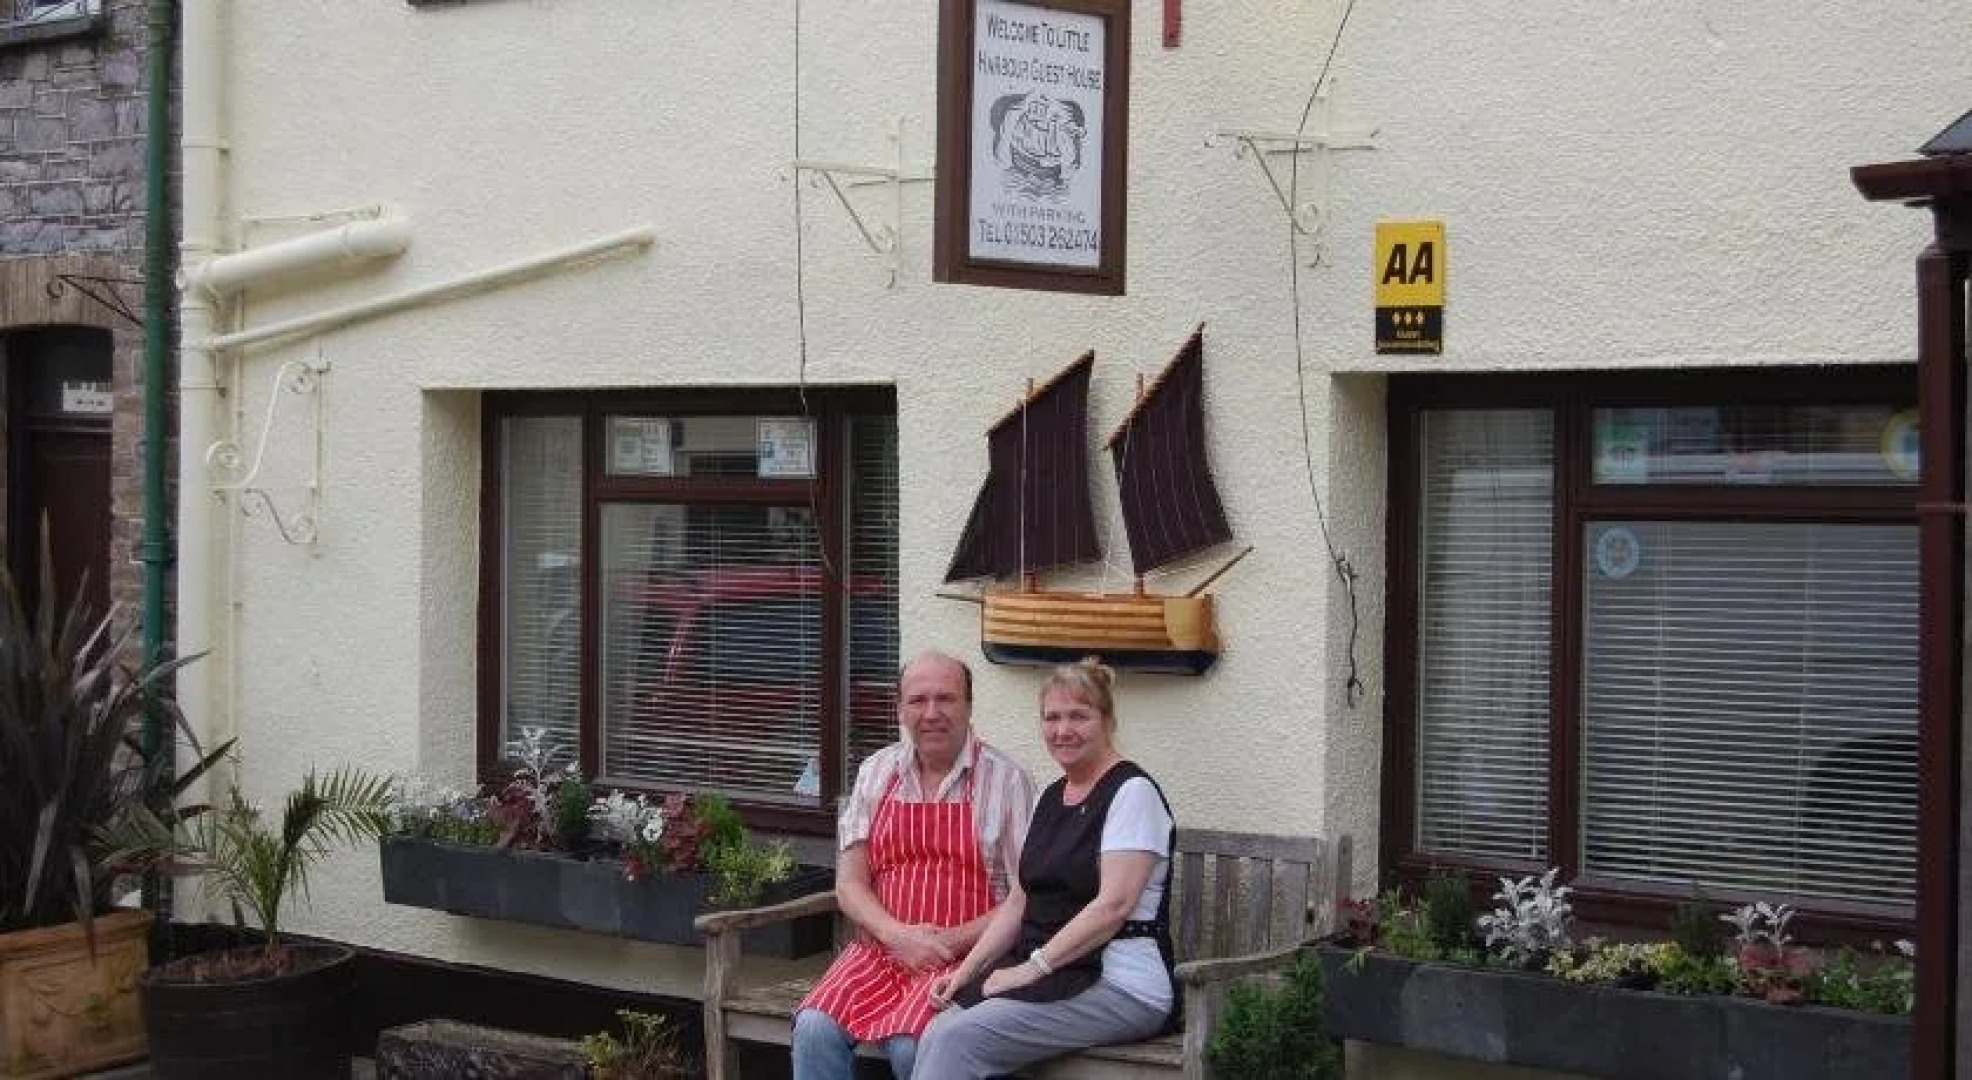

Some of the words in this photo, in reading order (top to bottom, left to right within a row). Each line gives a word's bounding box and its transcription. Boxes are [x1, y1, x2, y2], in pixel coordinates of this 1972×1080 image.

[986, 14, 1039, 43] WELCOME
[1041, 22, 1055, 47] TO
[1056, 27, 1090, 52] LITTLE
[978, 50, 1028, 81] HARBOUR
[1031, 58, 1065, 84] GUEST
[1066, 66, 1101, 89] HOUSE
[992, 203, 1026, 218] WITH
[1030, 206, 1086, 223] PARKING
[1381, 242, 1433, 284] AA
